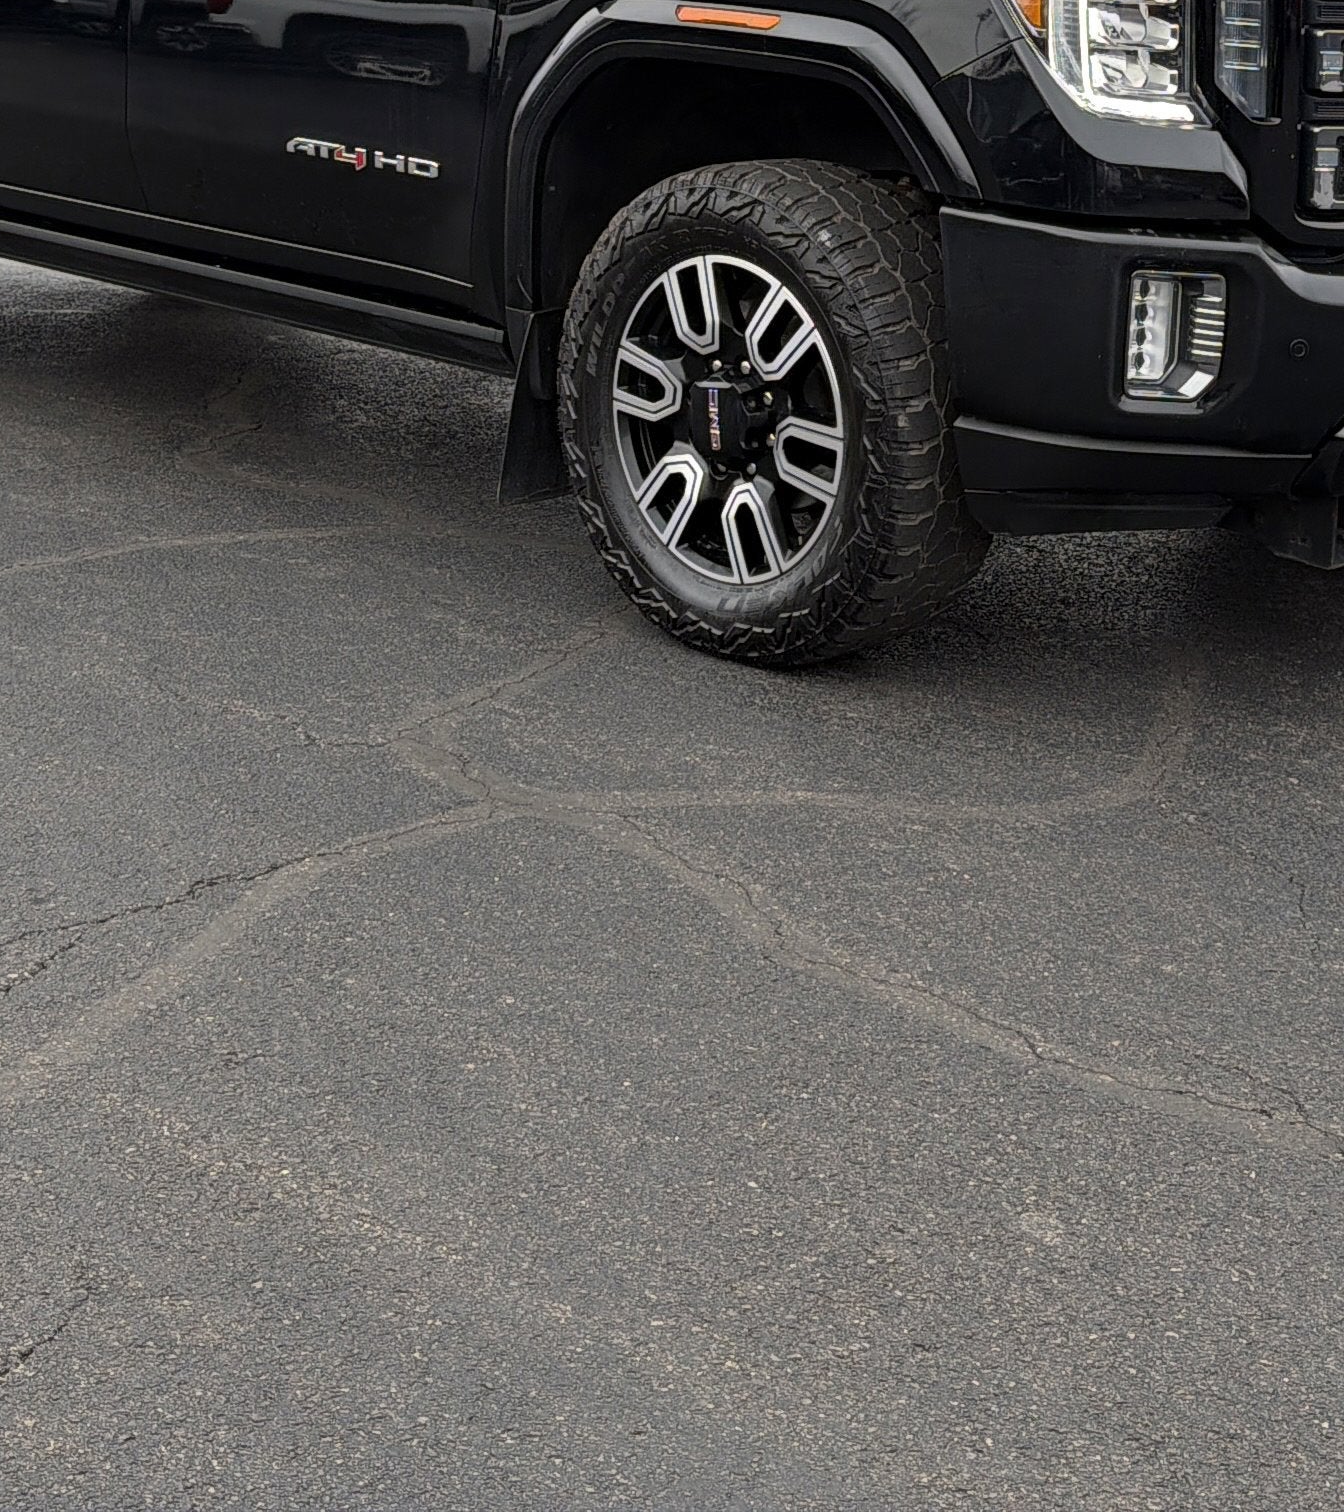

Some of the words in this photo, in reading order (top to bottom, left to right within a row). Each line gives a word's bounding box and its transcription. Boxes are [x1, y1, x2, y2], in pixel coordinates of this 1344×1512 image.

[286, 137, 367, 172] AT4
[374, 150, 440, 179] HD
[708, 388, 722, 451] GMC
